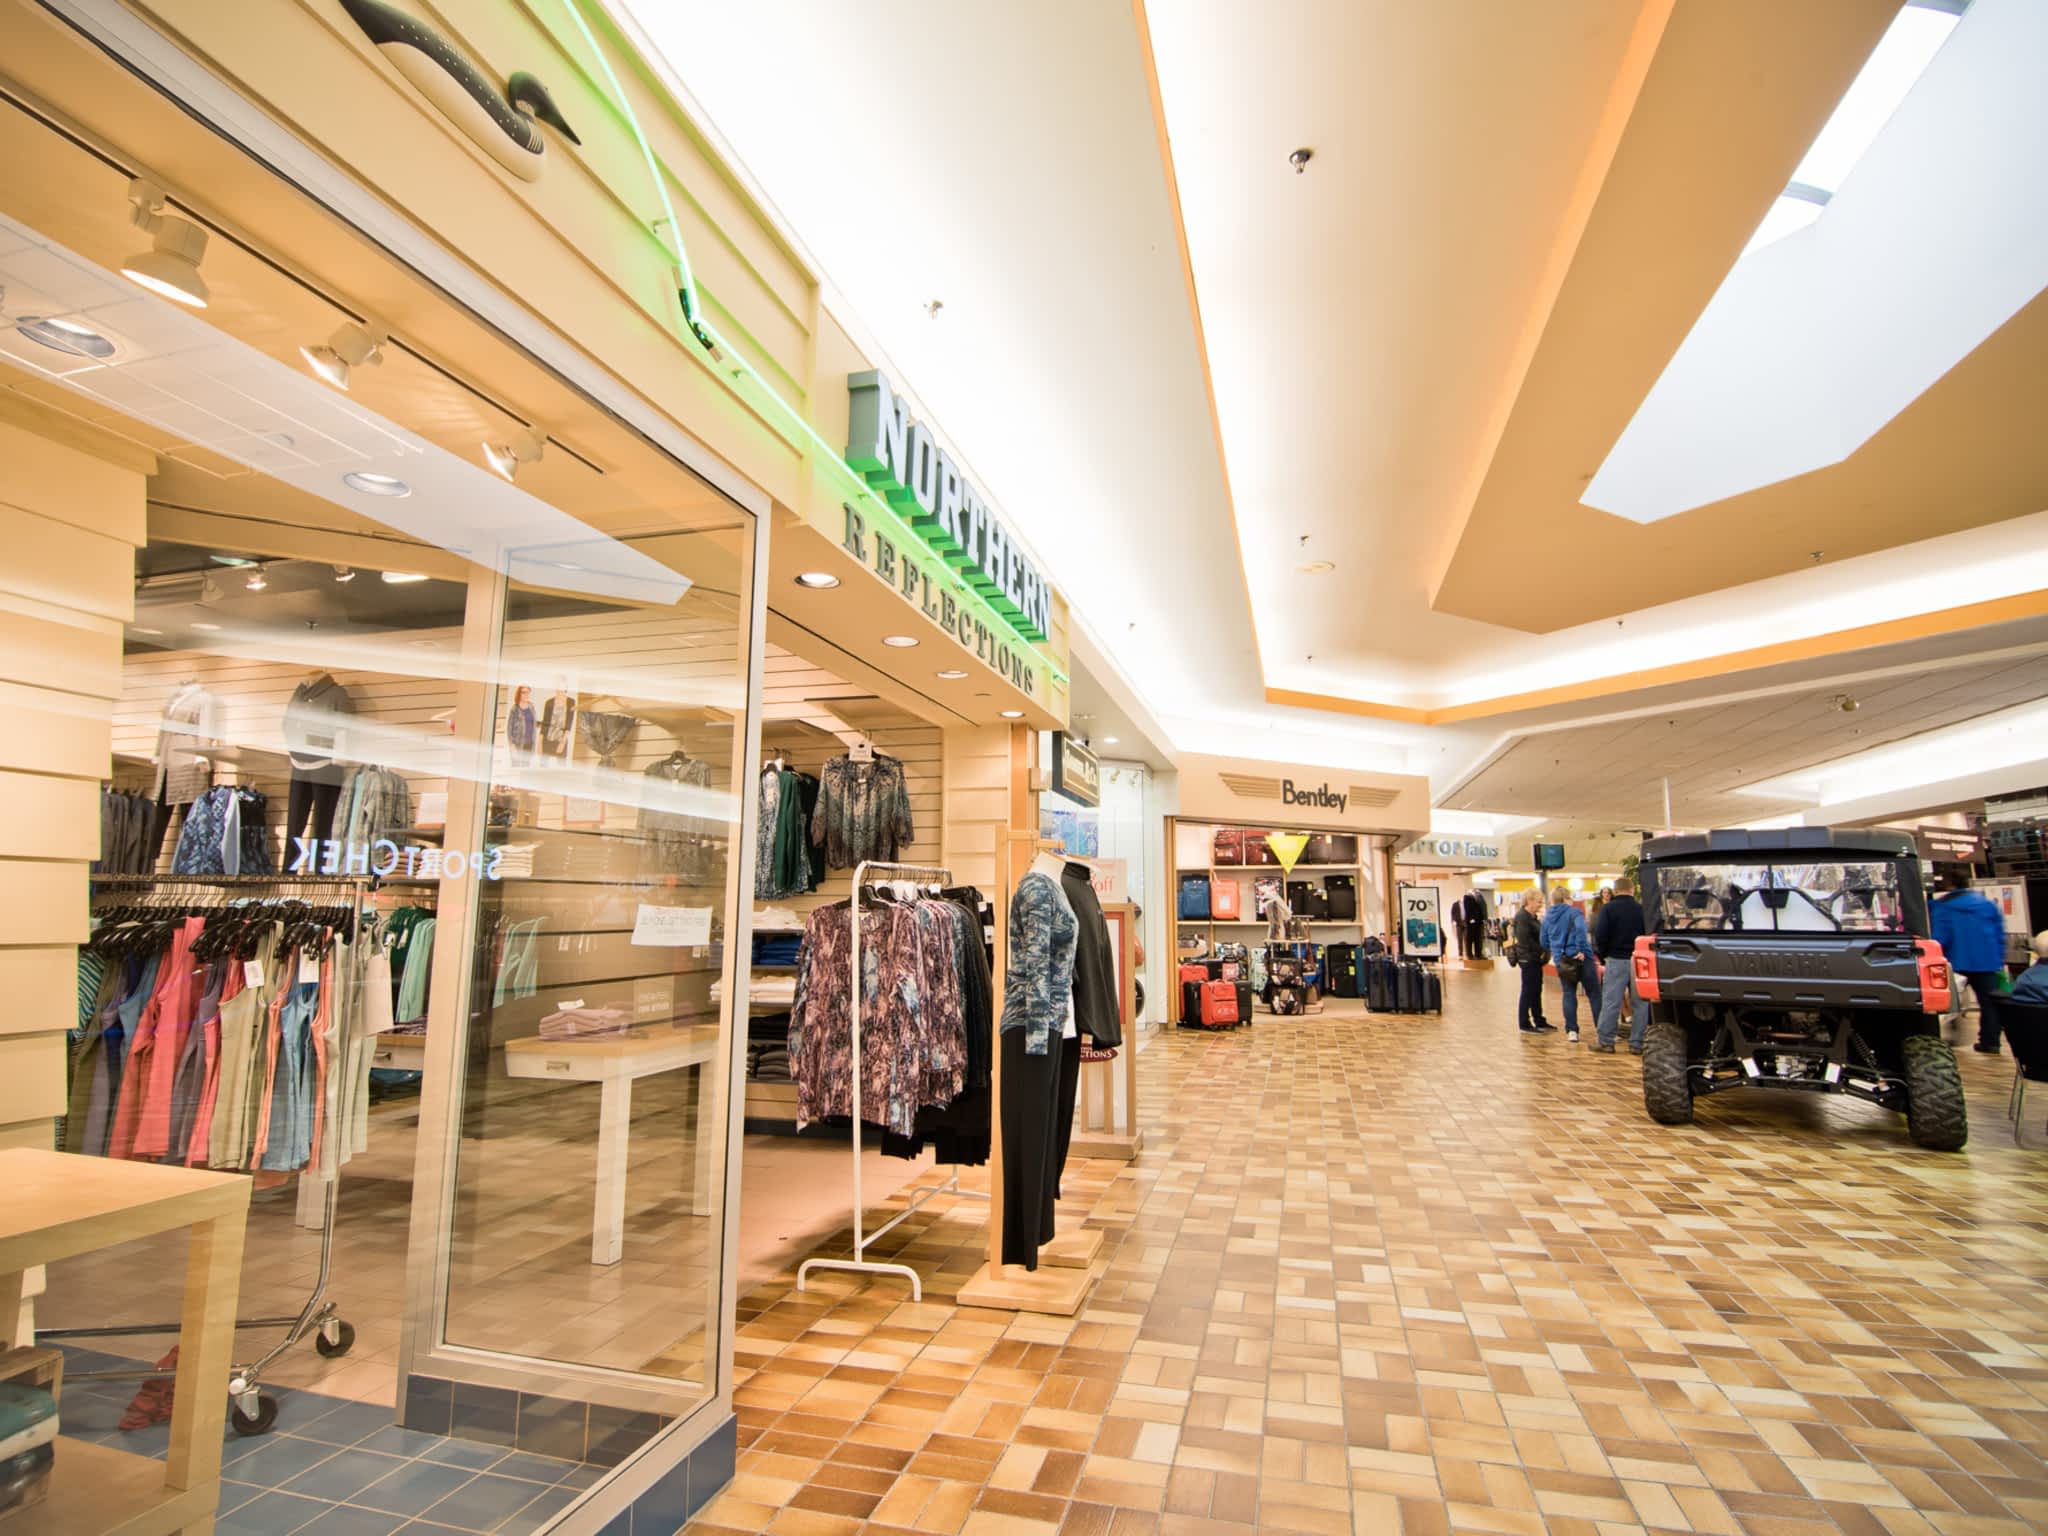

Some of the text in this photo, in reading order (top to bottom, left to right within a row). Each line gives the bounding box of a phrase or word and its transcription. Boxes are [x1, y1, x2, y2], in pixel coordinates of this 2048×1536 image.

[842, 501, 1034, 694] REFLECTIONS
[848, 368, 1051, 642] NORTHERN
[1282, 778, 1347, 814] Bentley
